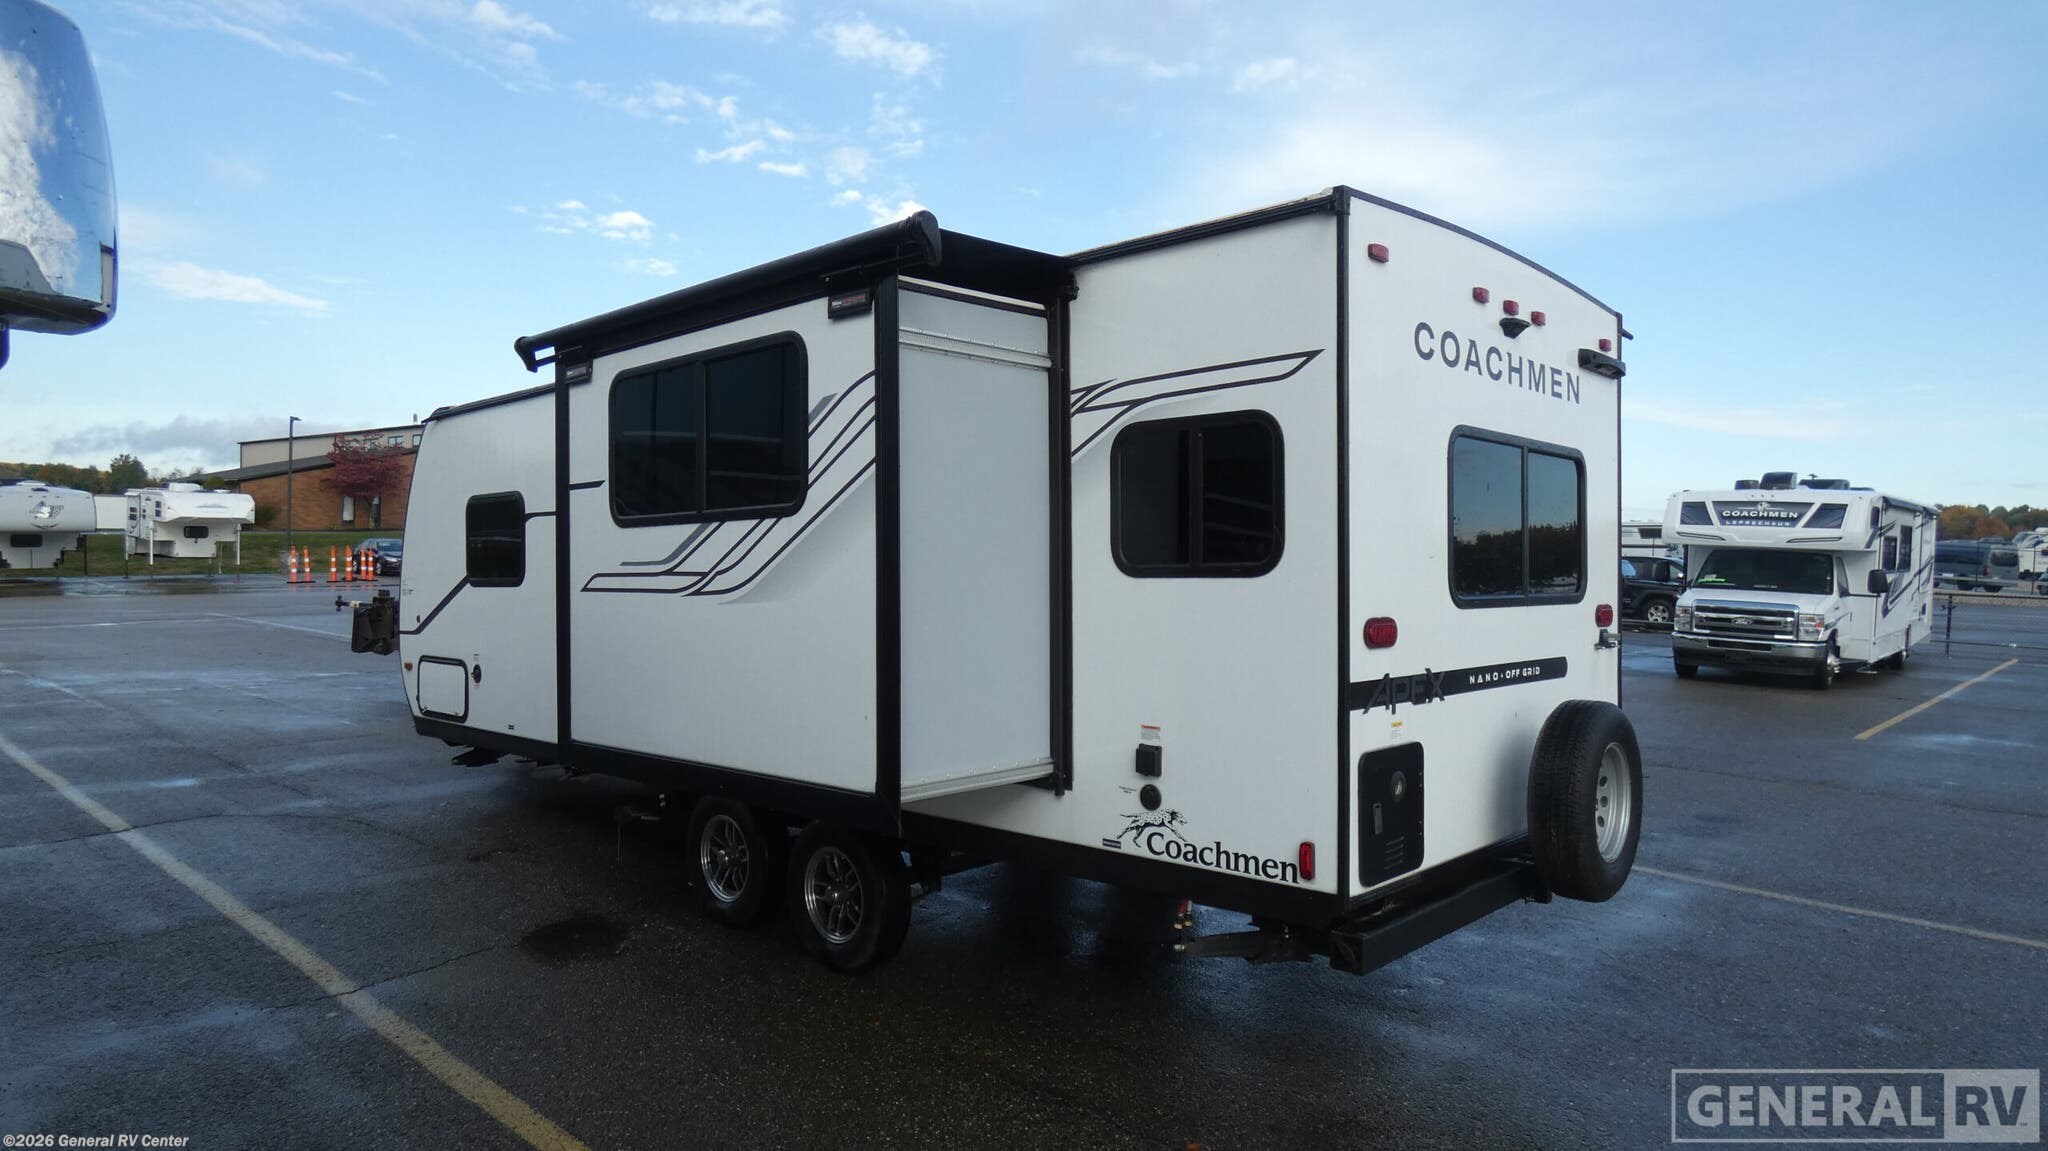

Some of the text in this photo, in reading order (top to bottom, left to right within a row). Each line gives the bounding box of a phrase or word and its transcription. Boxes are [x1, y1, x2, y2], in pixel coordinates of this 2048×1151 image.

[1414, 321, 1580, 405] COACHMEN
[1722, 510, 1798, 519] COACHMEN
[1362, 667, 1446, 715] APEX
[1469, 672, 1499, 685] NANO
[1522, 666, 1541, 677] GRID
[1146, 831, 1300, 885] Coachmen
